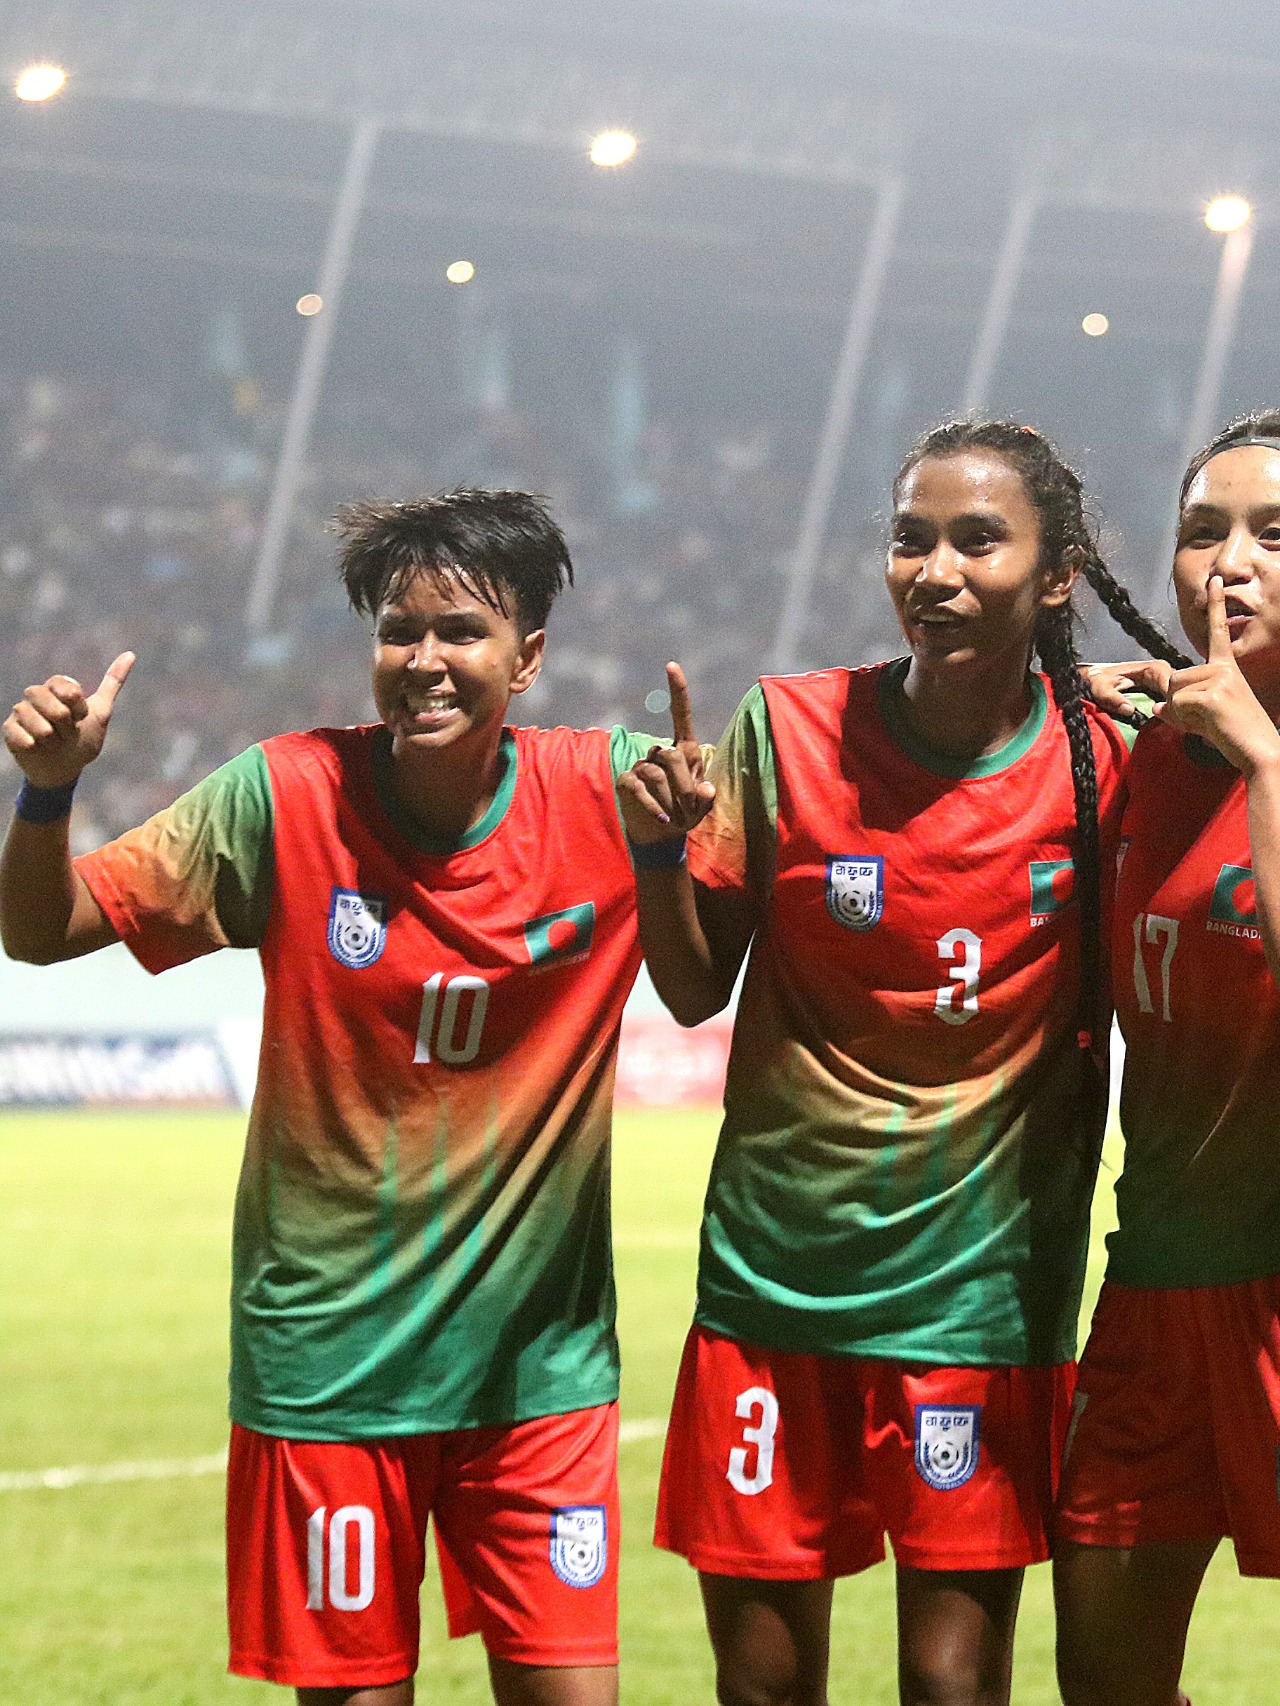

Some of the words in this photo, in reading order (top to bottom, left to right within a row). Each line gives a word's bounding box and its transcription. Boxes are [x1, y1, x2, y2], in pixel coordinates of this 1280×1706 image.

[934, 928, 982, 1025] 3
[1132, 912, 1181, 1022] 17
[1206, 920, 1261, 940] BANGLAD
[412, 972, 489, 1064] 10
[725, 1386, 779, 1496] 3
[306, 1505, 376, 1611] 10
